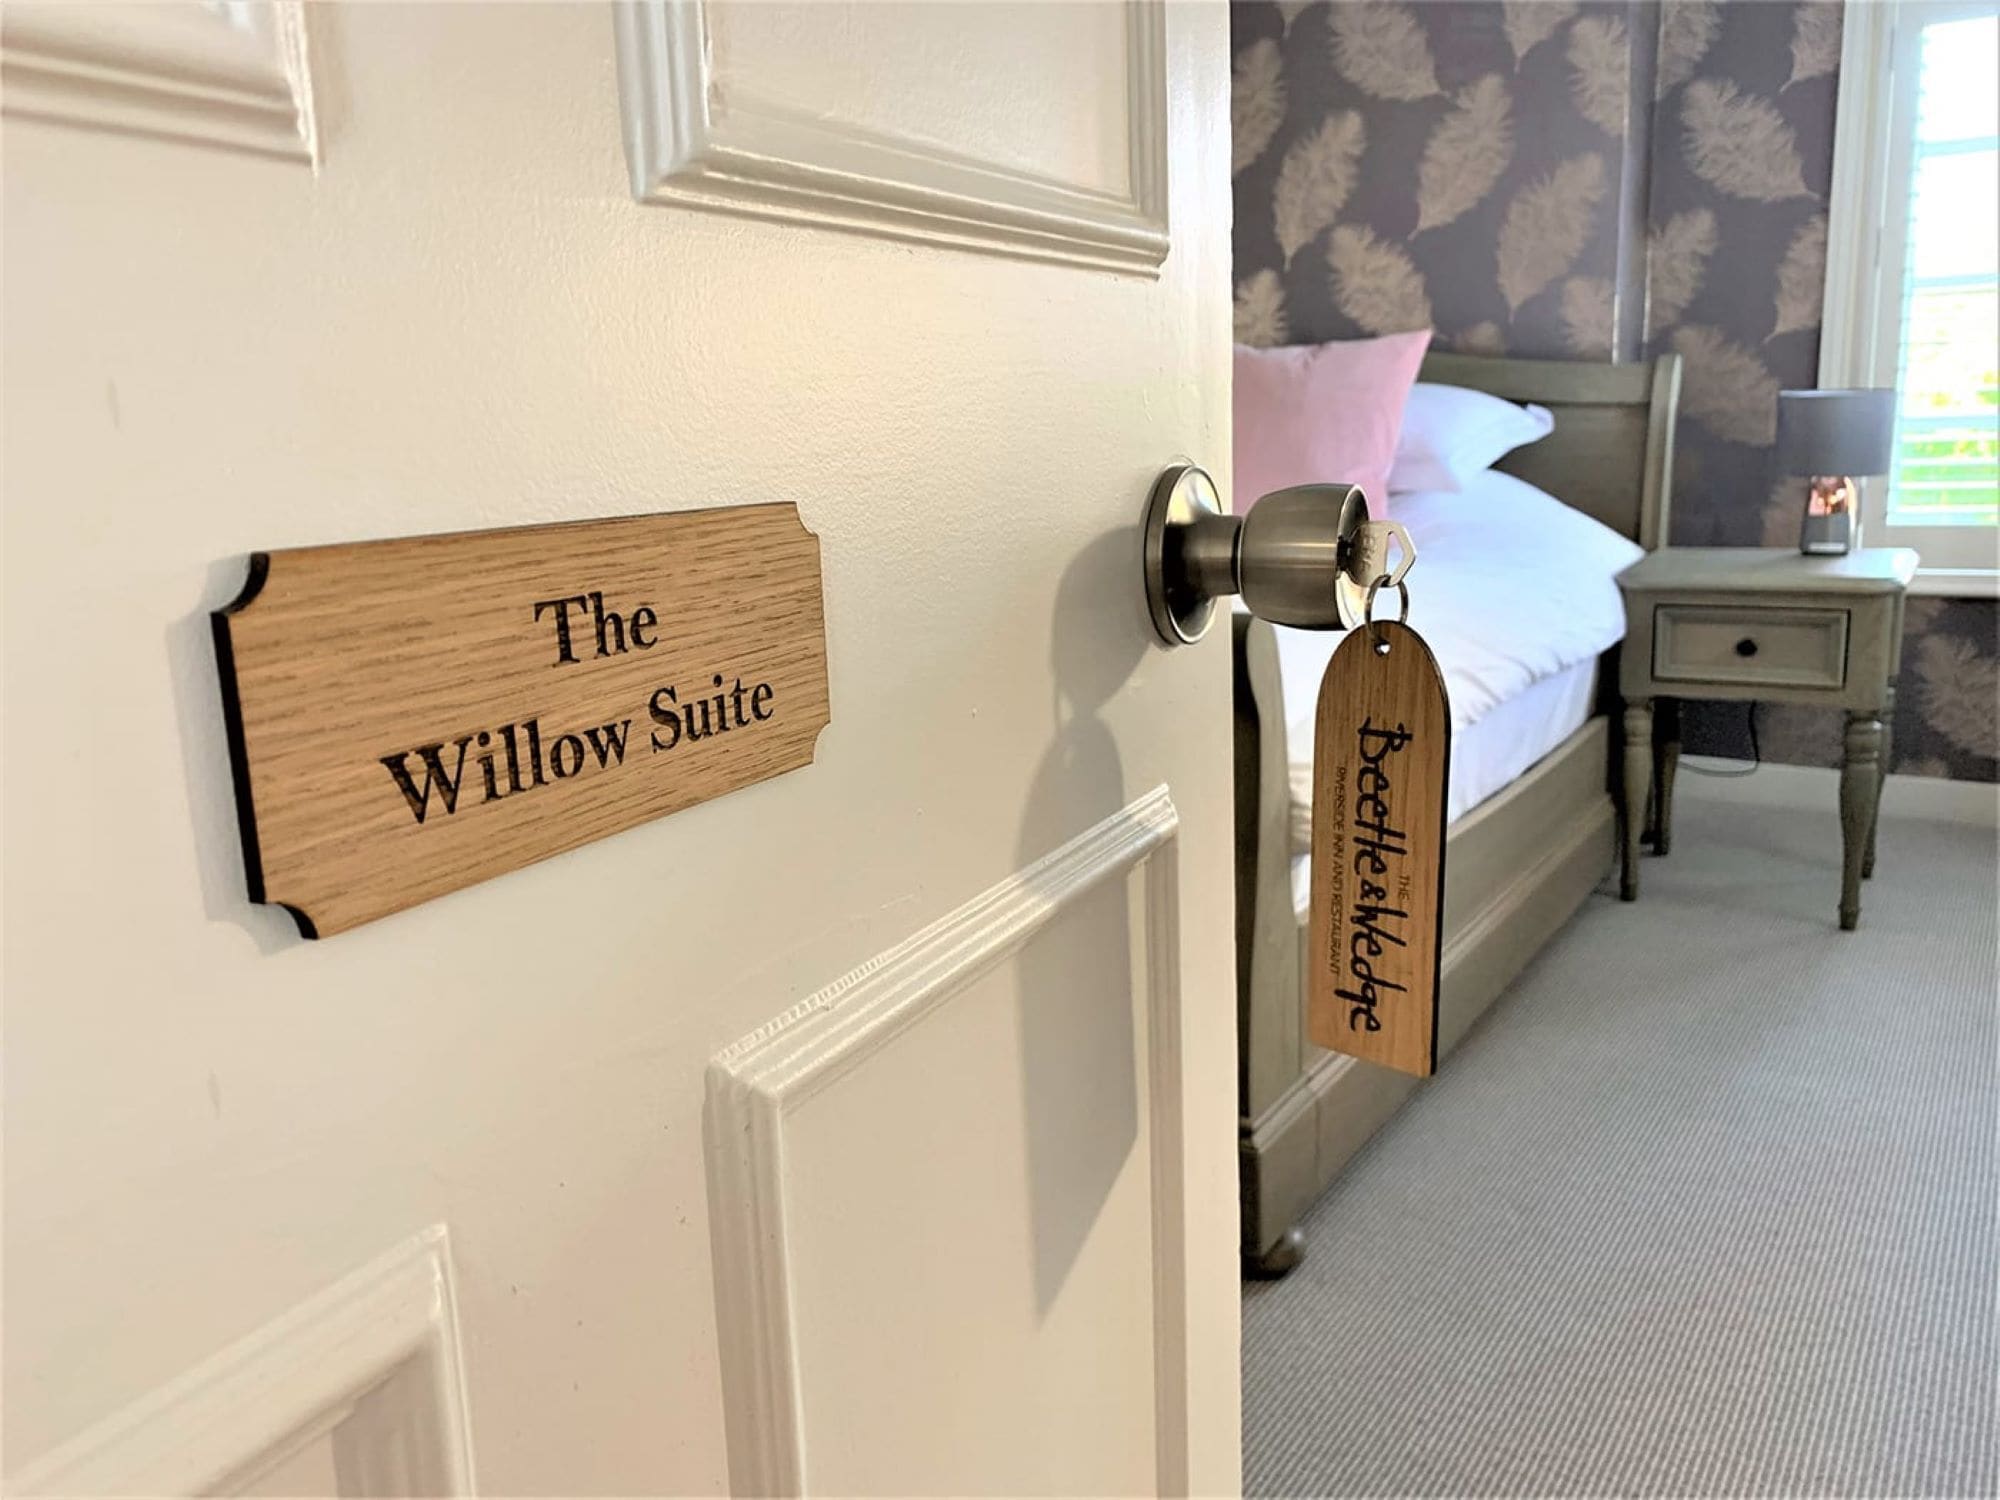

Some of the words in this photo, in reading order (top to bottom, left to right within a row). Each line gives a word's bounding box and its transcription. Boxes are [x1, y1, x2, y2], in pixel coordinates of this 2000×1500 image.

[533, 591, 658, 668] The
[379, 718, 632, 824] Willow
[649, 674, 774, 754] Suite
[1331, 766, 1346, 831] RIVERSIDE
[1353, 716, 1413, 876] Beetle
[1331, 861, 1345, 891] AND
[1332, 834, 1345, 858] INN
[1360, 879, 1386, 901] &
[1397, 874, 1410, 900] THE
[1329, 893, 1344, 977] RESTAURANT
[1334, 904, 1408, 1032] Wedge
